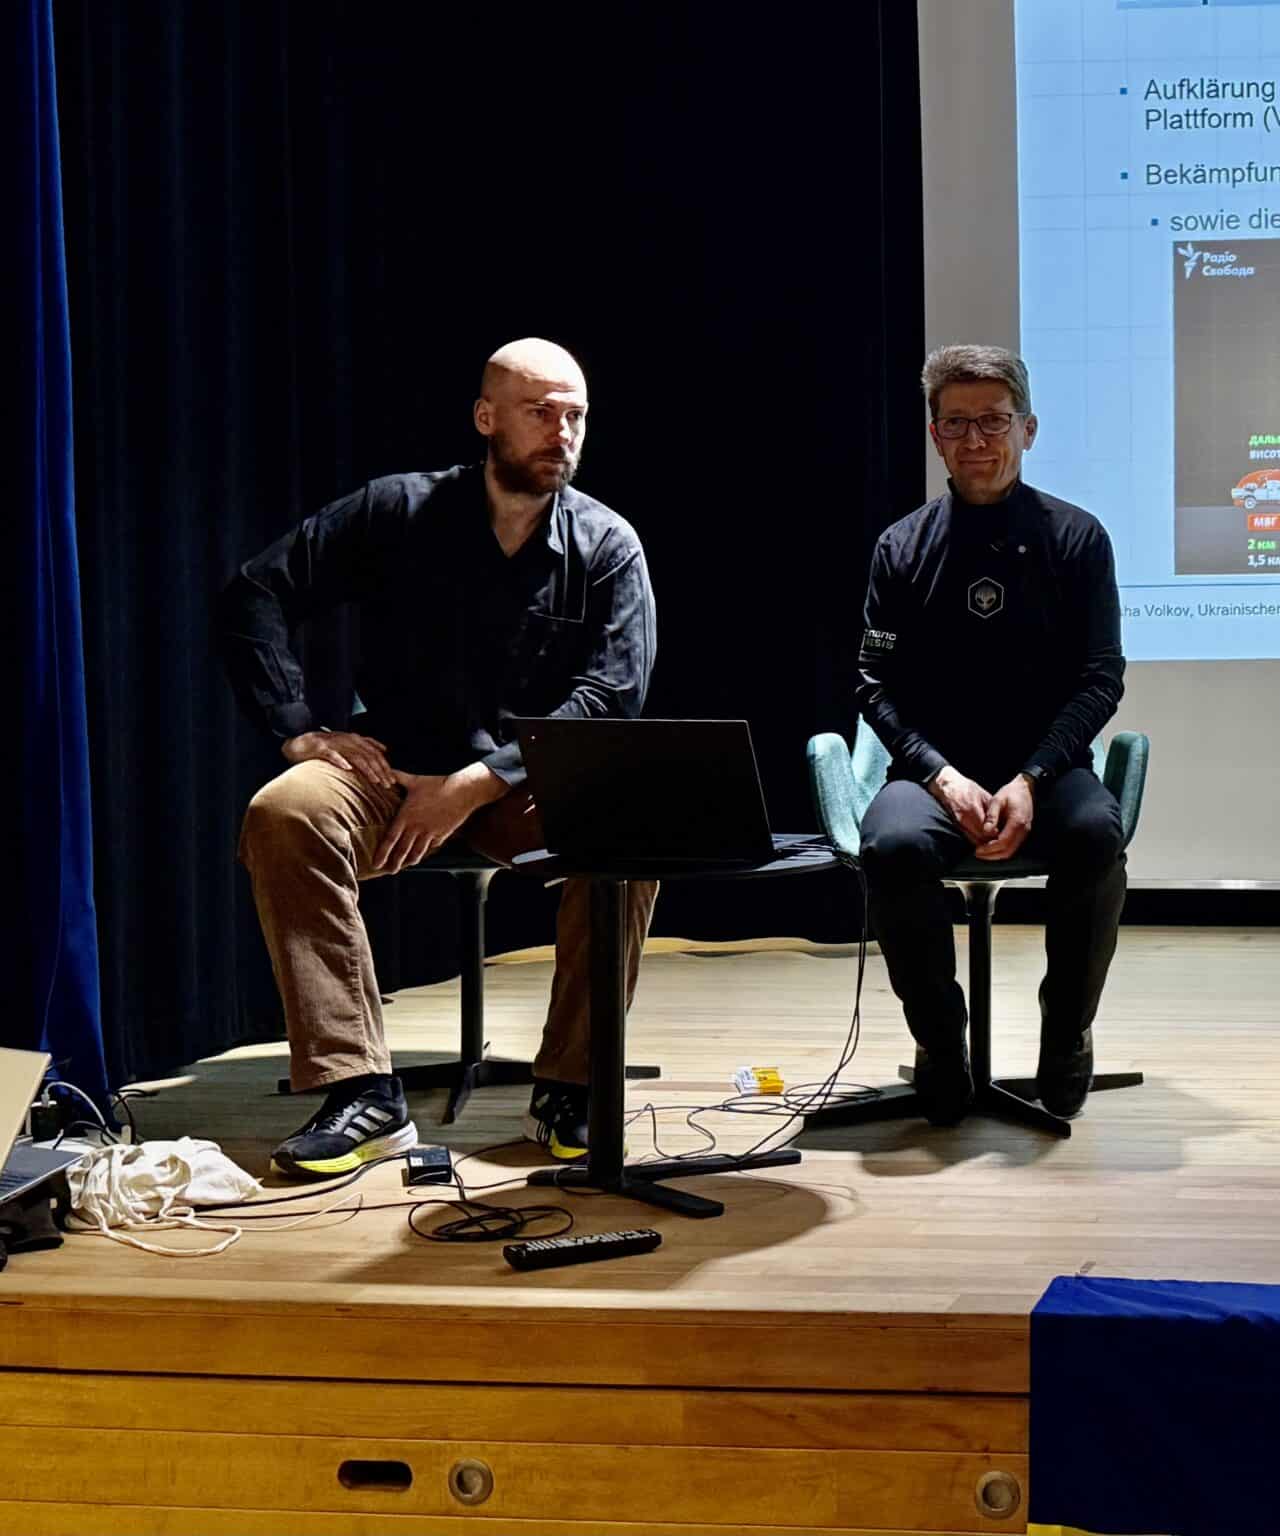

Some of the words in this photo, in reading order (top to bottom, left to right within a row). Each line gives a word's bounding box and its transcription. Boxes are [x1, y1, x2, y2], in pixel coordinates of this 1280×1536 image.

[1144, 78, 1275, 103] Aufklärung
[1146, 108, 1253, 130] Plattform
[1170, 209, 1240, 231] sowie
[1202, 251, 1237, 262] Радіо
[1202, 264, 1255, 277] Свобода
[1248, 539, 1255, 549] 2
[1248, 555, 1265, 566] 1,5
[1121, 605, 1140, 617] ha
[1144, 604, 1194, 619] Volkov,
[1198, 603, 1280, 617] Ukrainischer
